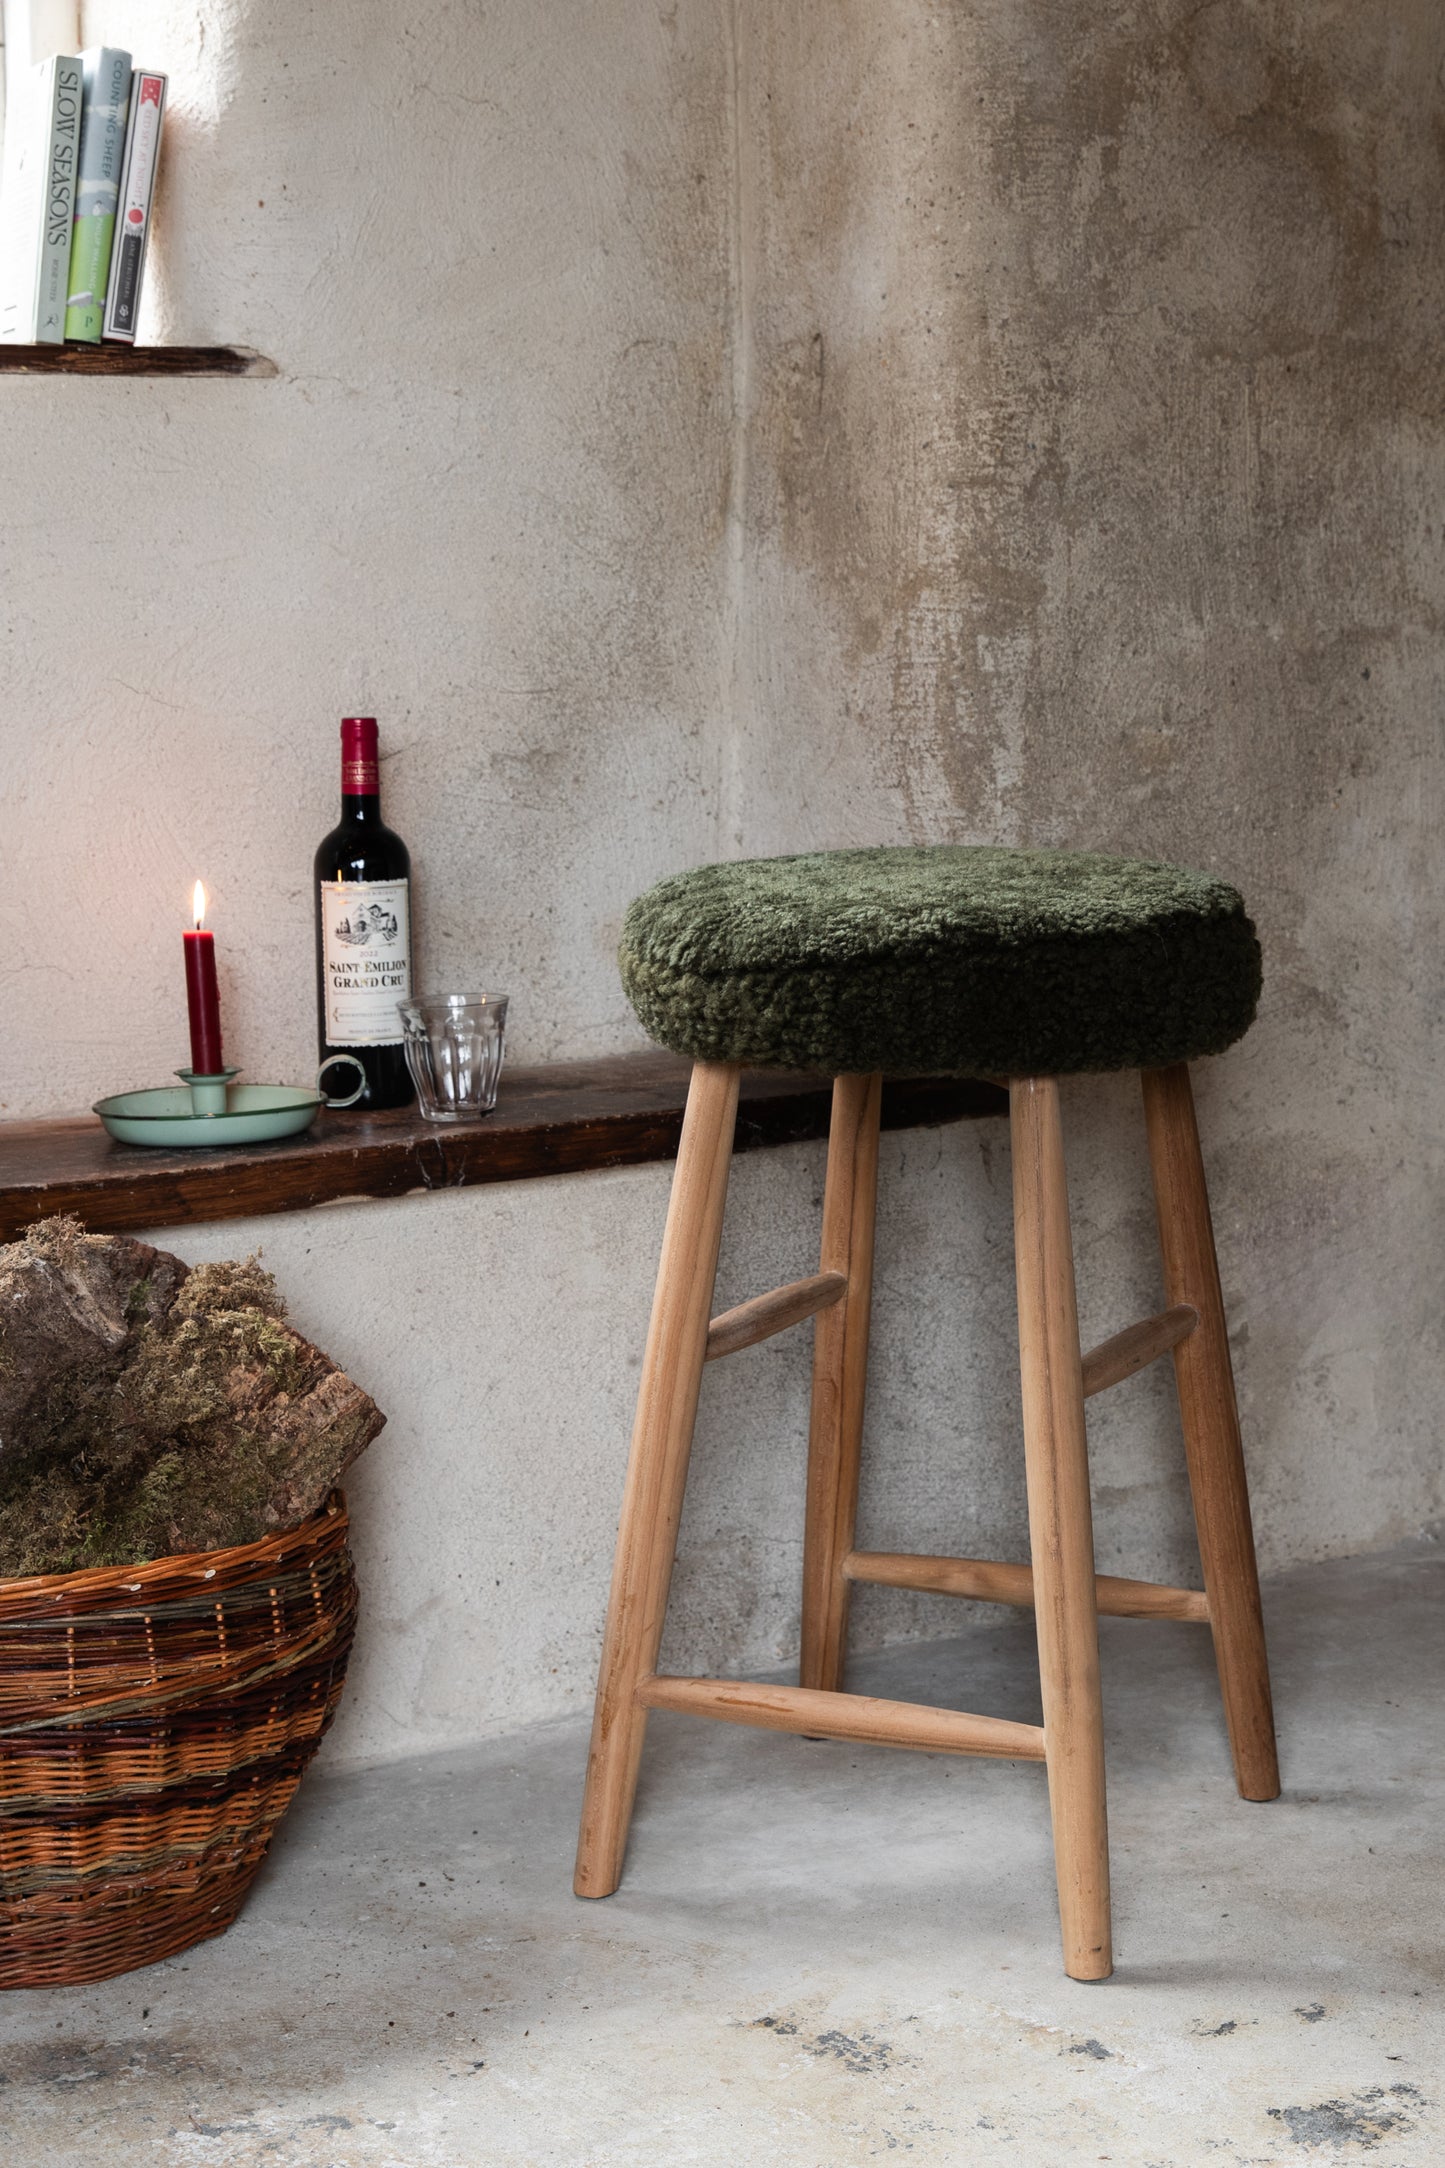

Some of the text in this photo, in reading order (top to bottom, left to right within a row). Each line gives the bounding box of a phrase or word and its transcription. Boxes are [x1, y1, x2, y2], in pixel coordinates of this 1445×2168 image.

[102, 60, 123, 178] COUNTING SHEEP
[48, 71, 78, 246] SLOW SEASONS
[133, 167, 146, 201] NIGHT
[89, 217, 104, 289] PHILIP WALLING
[333, 973, 404, 989] GRAND CRU
